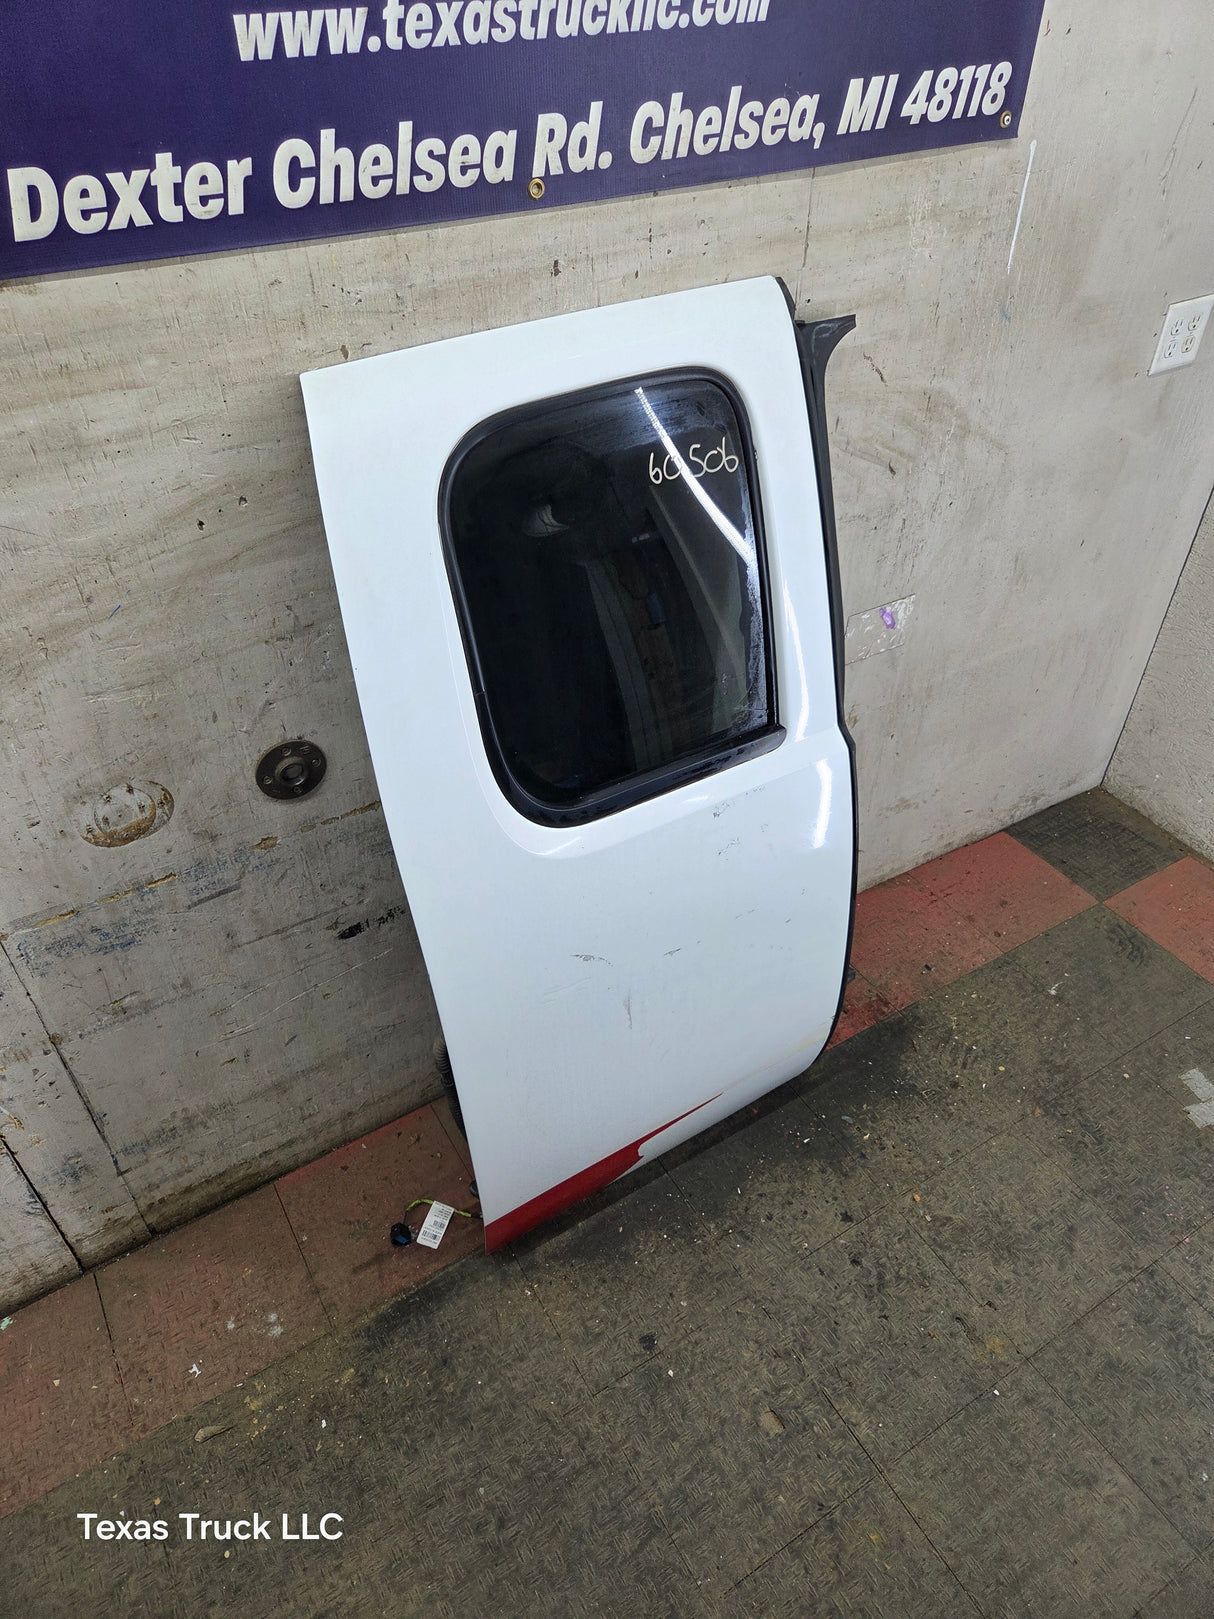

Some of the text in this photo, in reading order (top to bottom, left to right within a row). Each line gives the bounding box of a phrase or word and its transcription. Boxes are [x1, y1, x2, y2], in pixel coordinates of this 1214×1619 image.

[7, 60, 1013, 242] Dexter Chelsea Rd. Chelsea, MI 48118
